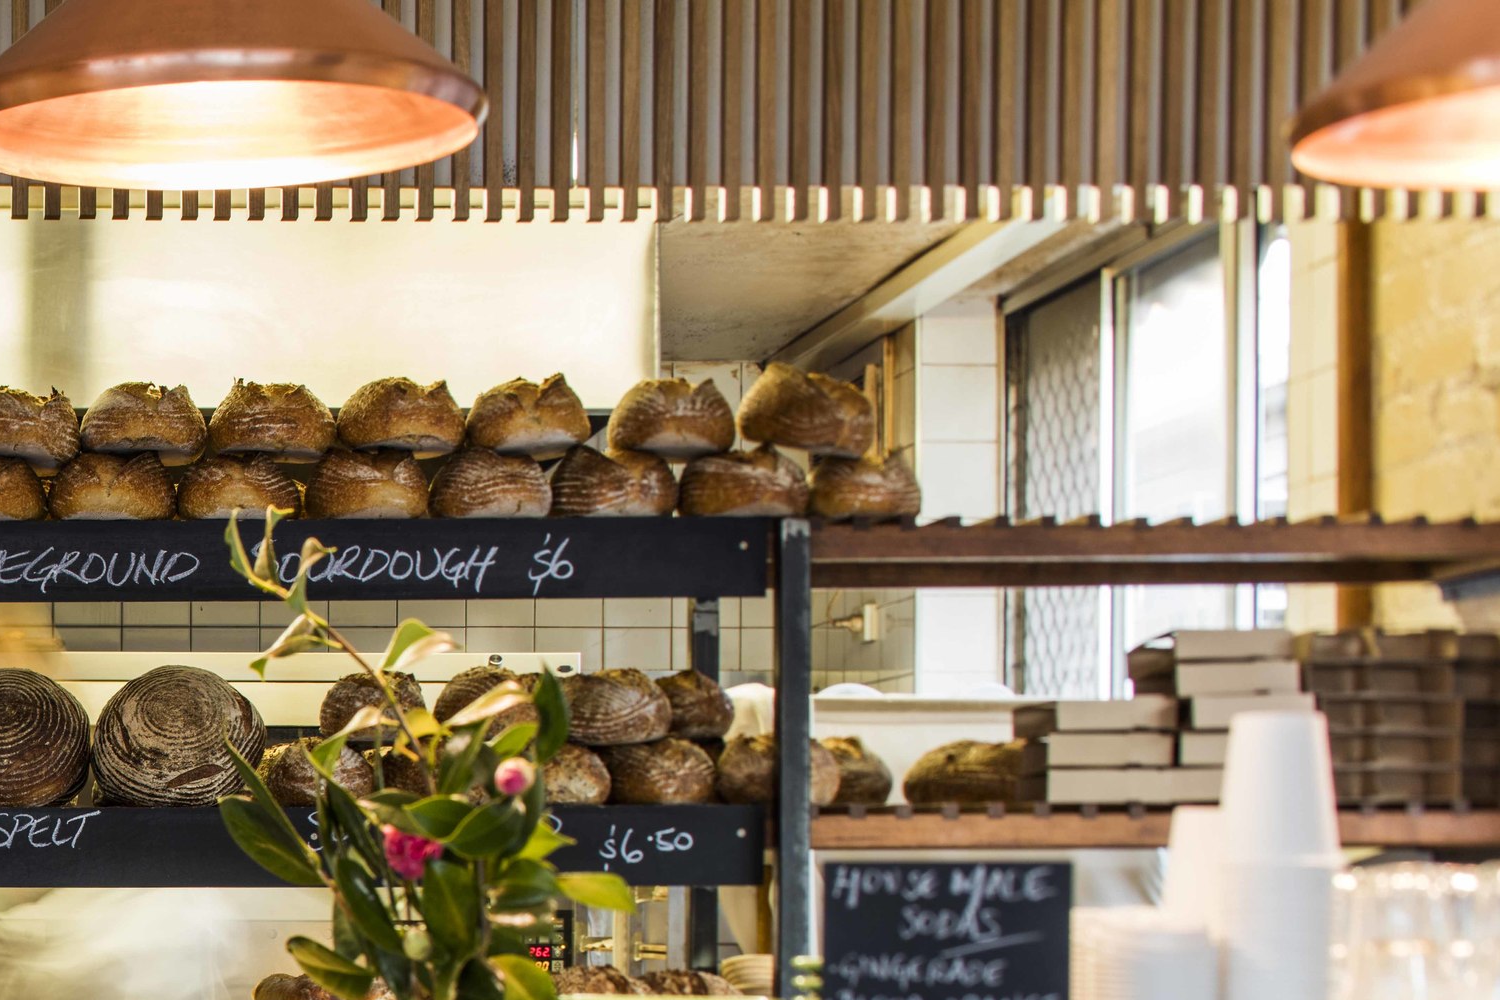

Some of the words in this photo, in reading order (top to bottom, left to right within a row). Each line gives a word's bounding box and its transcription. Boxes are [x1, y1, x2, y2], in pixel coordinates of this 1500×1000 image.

[528, 533, 575, 597] $6
[599, 824, 694, 872] $6.50
[832, 866, 938, 910] HOUSE
[898, 903, 1002, 942] SODAS
